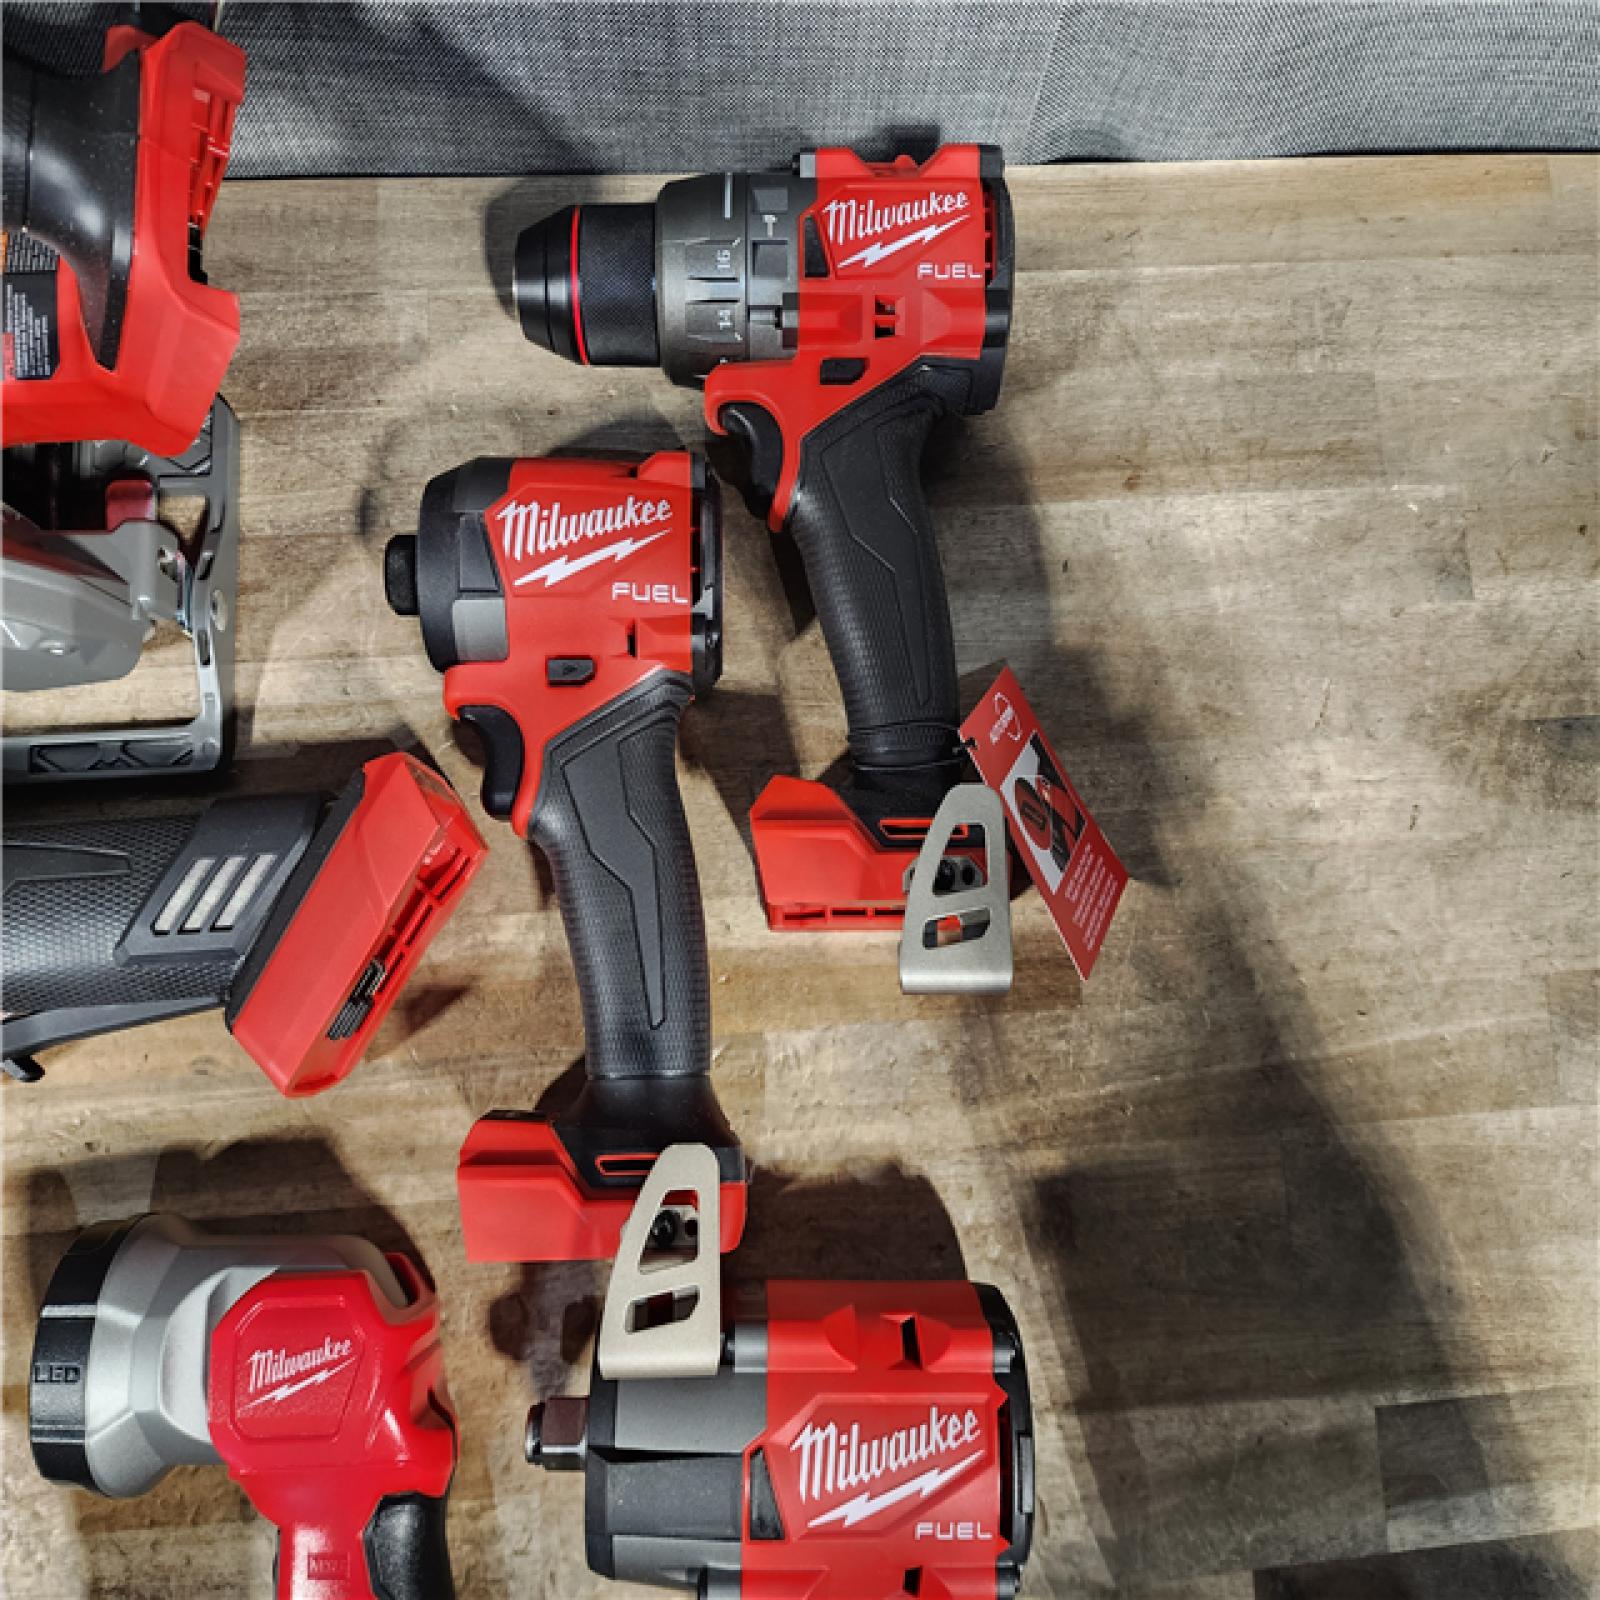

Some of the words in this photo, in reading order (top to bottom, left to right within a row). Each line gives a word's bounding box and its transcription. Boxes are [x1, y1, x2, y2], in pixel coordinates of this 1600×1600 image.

[822, 191, 969, 246] Milwaukee
[917, 263, 983, 279] FUEL
[496, 495, 673, 562] Milwaukee
[611, 582, 689, 604] FUEL
[34, 1363, 81, 1385] LED
[247, 1336, 353, 1394] Milwaukee
[789, 1406, 981, 1504] Milwaukee
[914, 1522, 992, 1540] FUEL
